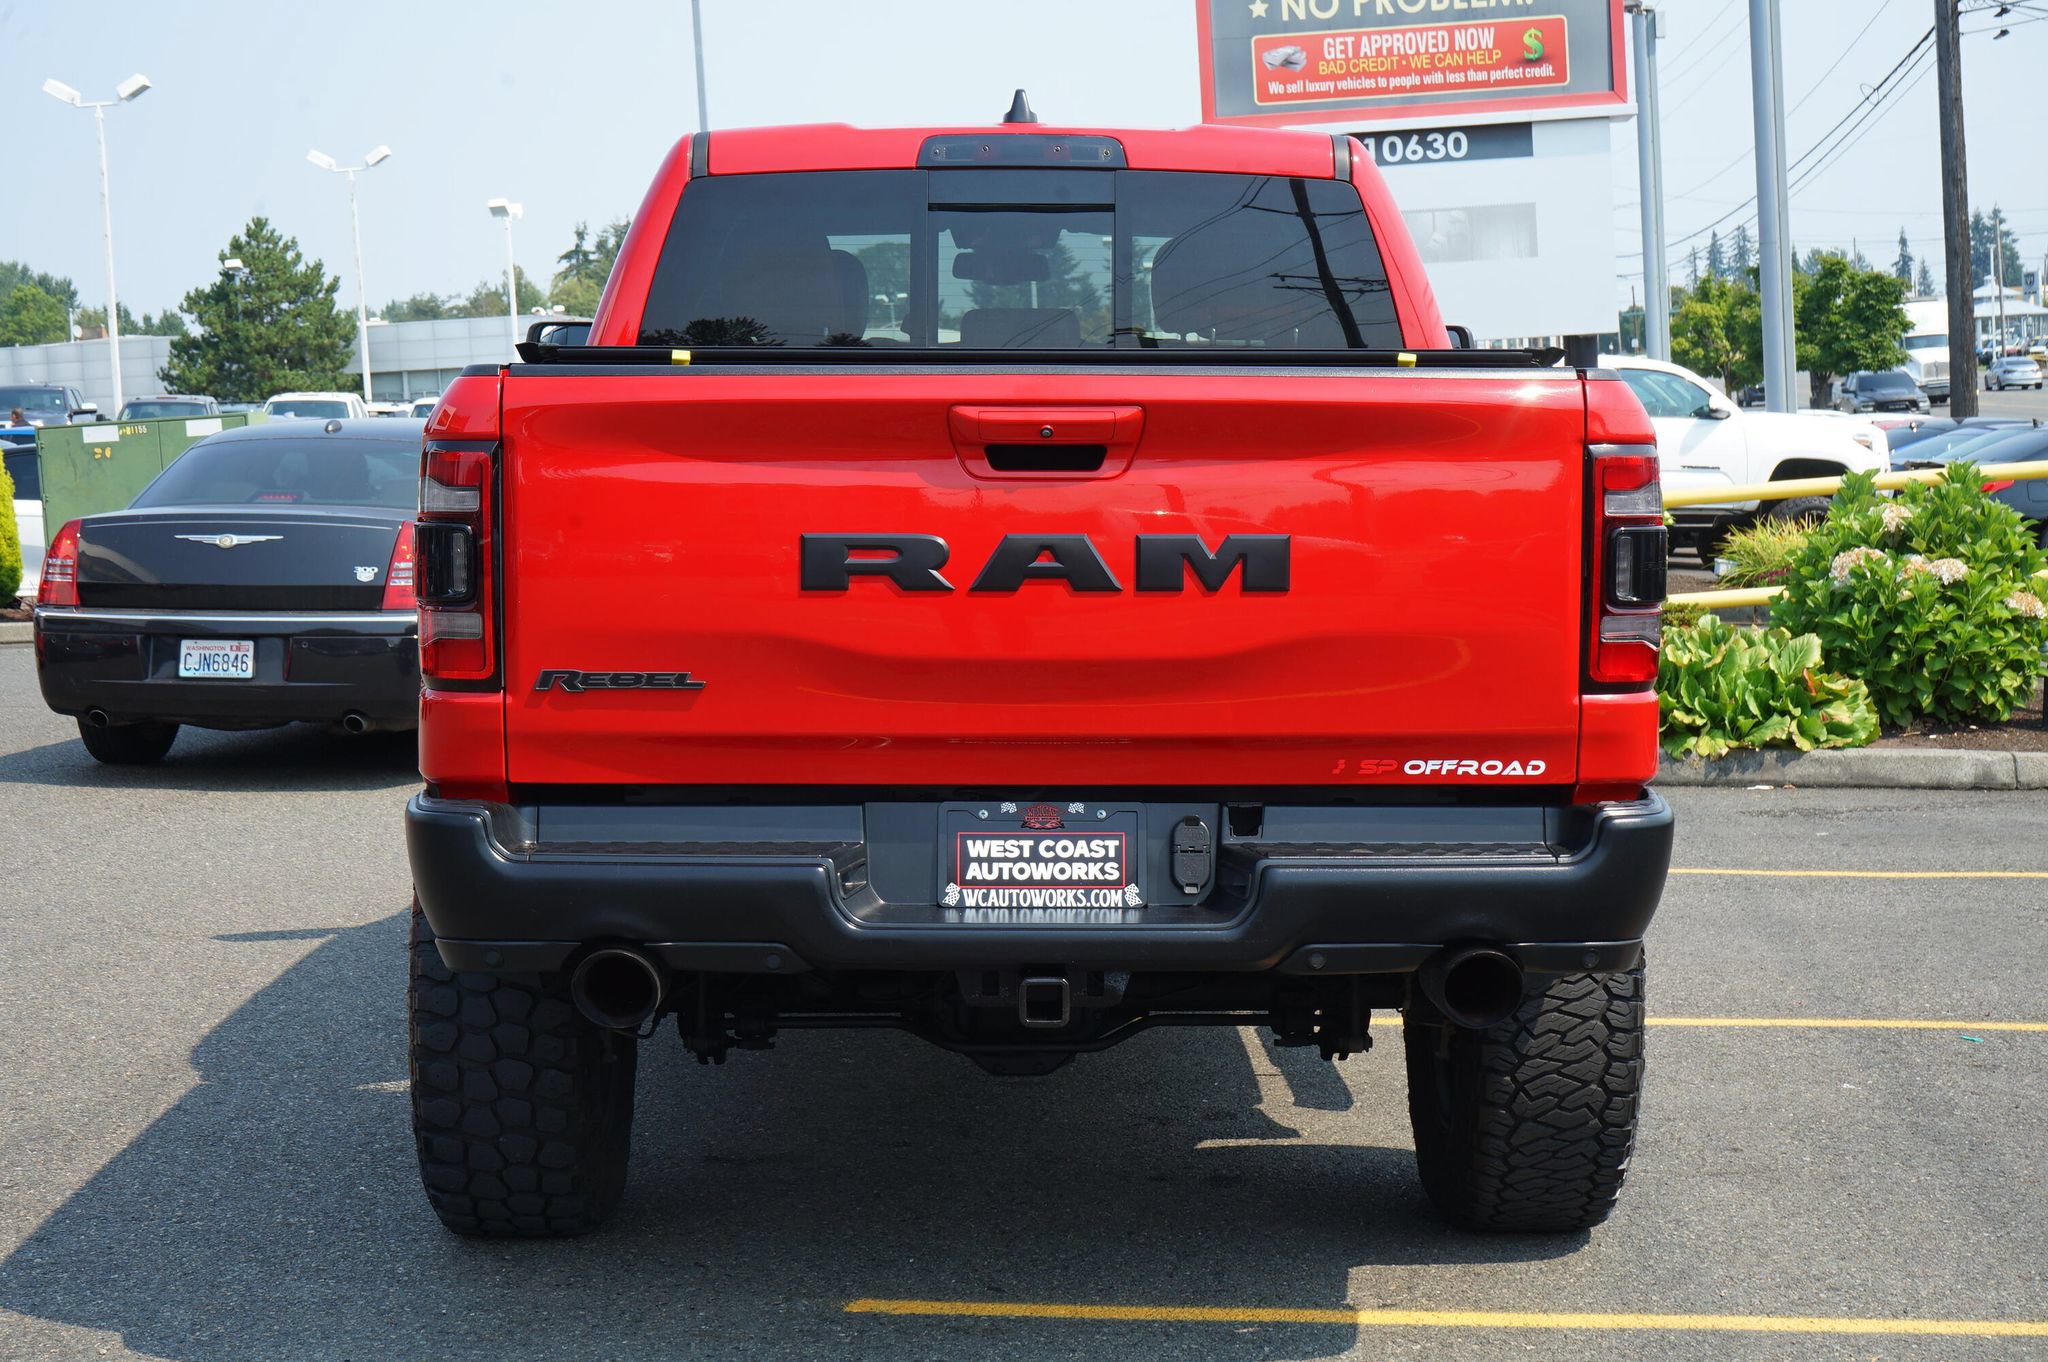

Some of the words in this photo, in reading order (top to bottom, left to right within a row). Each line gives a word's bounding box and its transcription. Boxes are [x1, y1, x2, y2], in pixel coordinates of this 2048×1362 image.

[1323, 36, 1355, 60] GET
[1359, 29, 1449, 59] APPROVED
[1454, 26, 1495, 51] NOW
[1318, 60, 1347, 75] BAD
[1349, 56, 1399, 73] CREDIT
[1409, 54, 1432, 69] WE
[1434, 51, 1463, 68] CAN
[1466, 49, 1502, 65] HELP
[1268, 81, 1285, 95] We
[1286, 79, 1304, 93] sell
[1306, 78, 1335, 94] luxury
[1336, 75, 1376, 90] vehicles
[1377, 76, 1388, 88] to
[1389, 72, 1421, 90] people
[1423, 70, 1444, 85] with
[1446, 69, 1465, 83] less
[1466, 67, 1488, 82] than
[1489, 66, 1523, 83] perfect
[1525, 63, 1556, 78] credit.
[1363, 131, 1468, 163] 10630
[800, 534, 1291, 592] RAM
[184, 652, 249, 672] CJN6846
[535, 669, 706, 692] REBEL
[1403, 759, 1547, 776] OFFROAD
[966, 839, 1034, 858] WEST
[1038, 839, 1120, 858] COAST
[965, 862, 1120, 881] AUTOWORKS
[963, 888, 1123, 907] WCAUTOWORKS.COM
